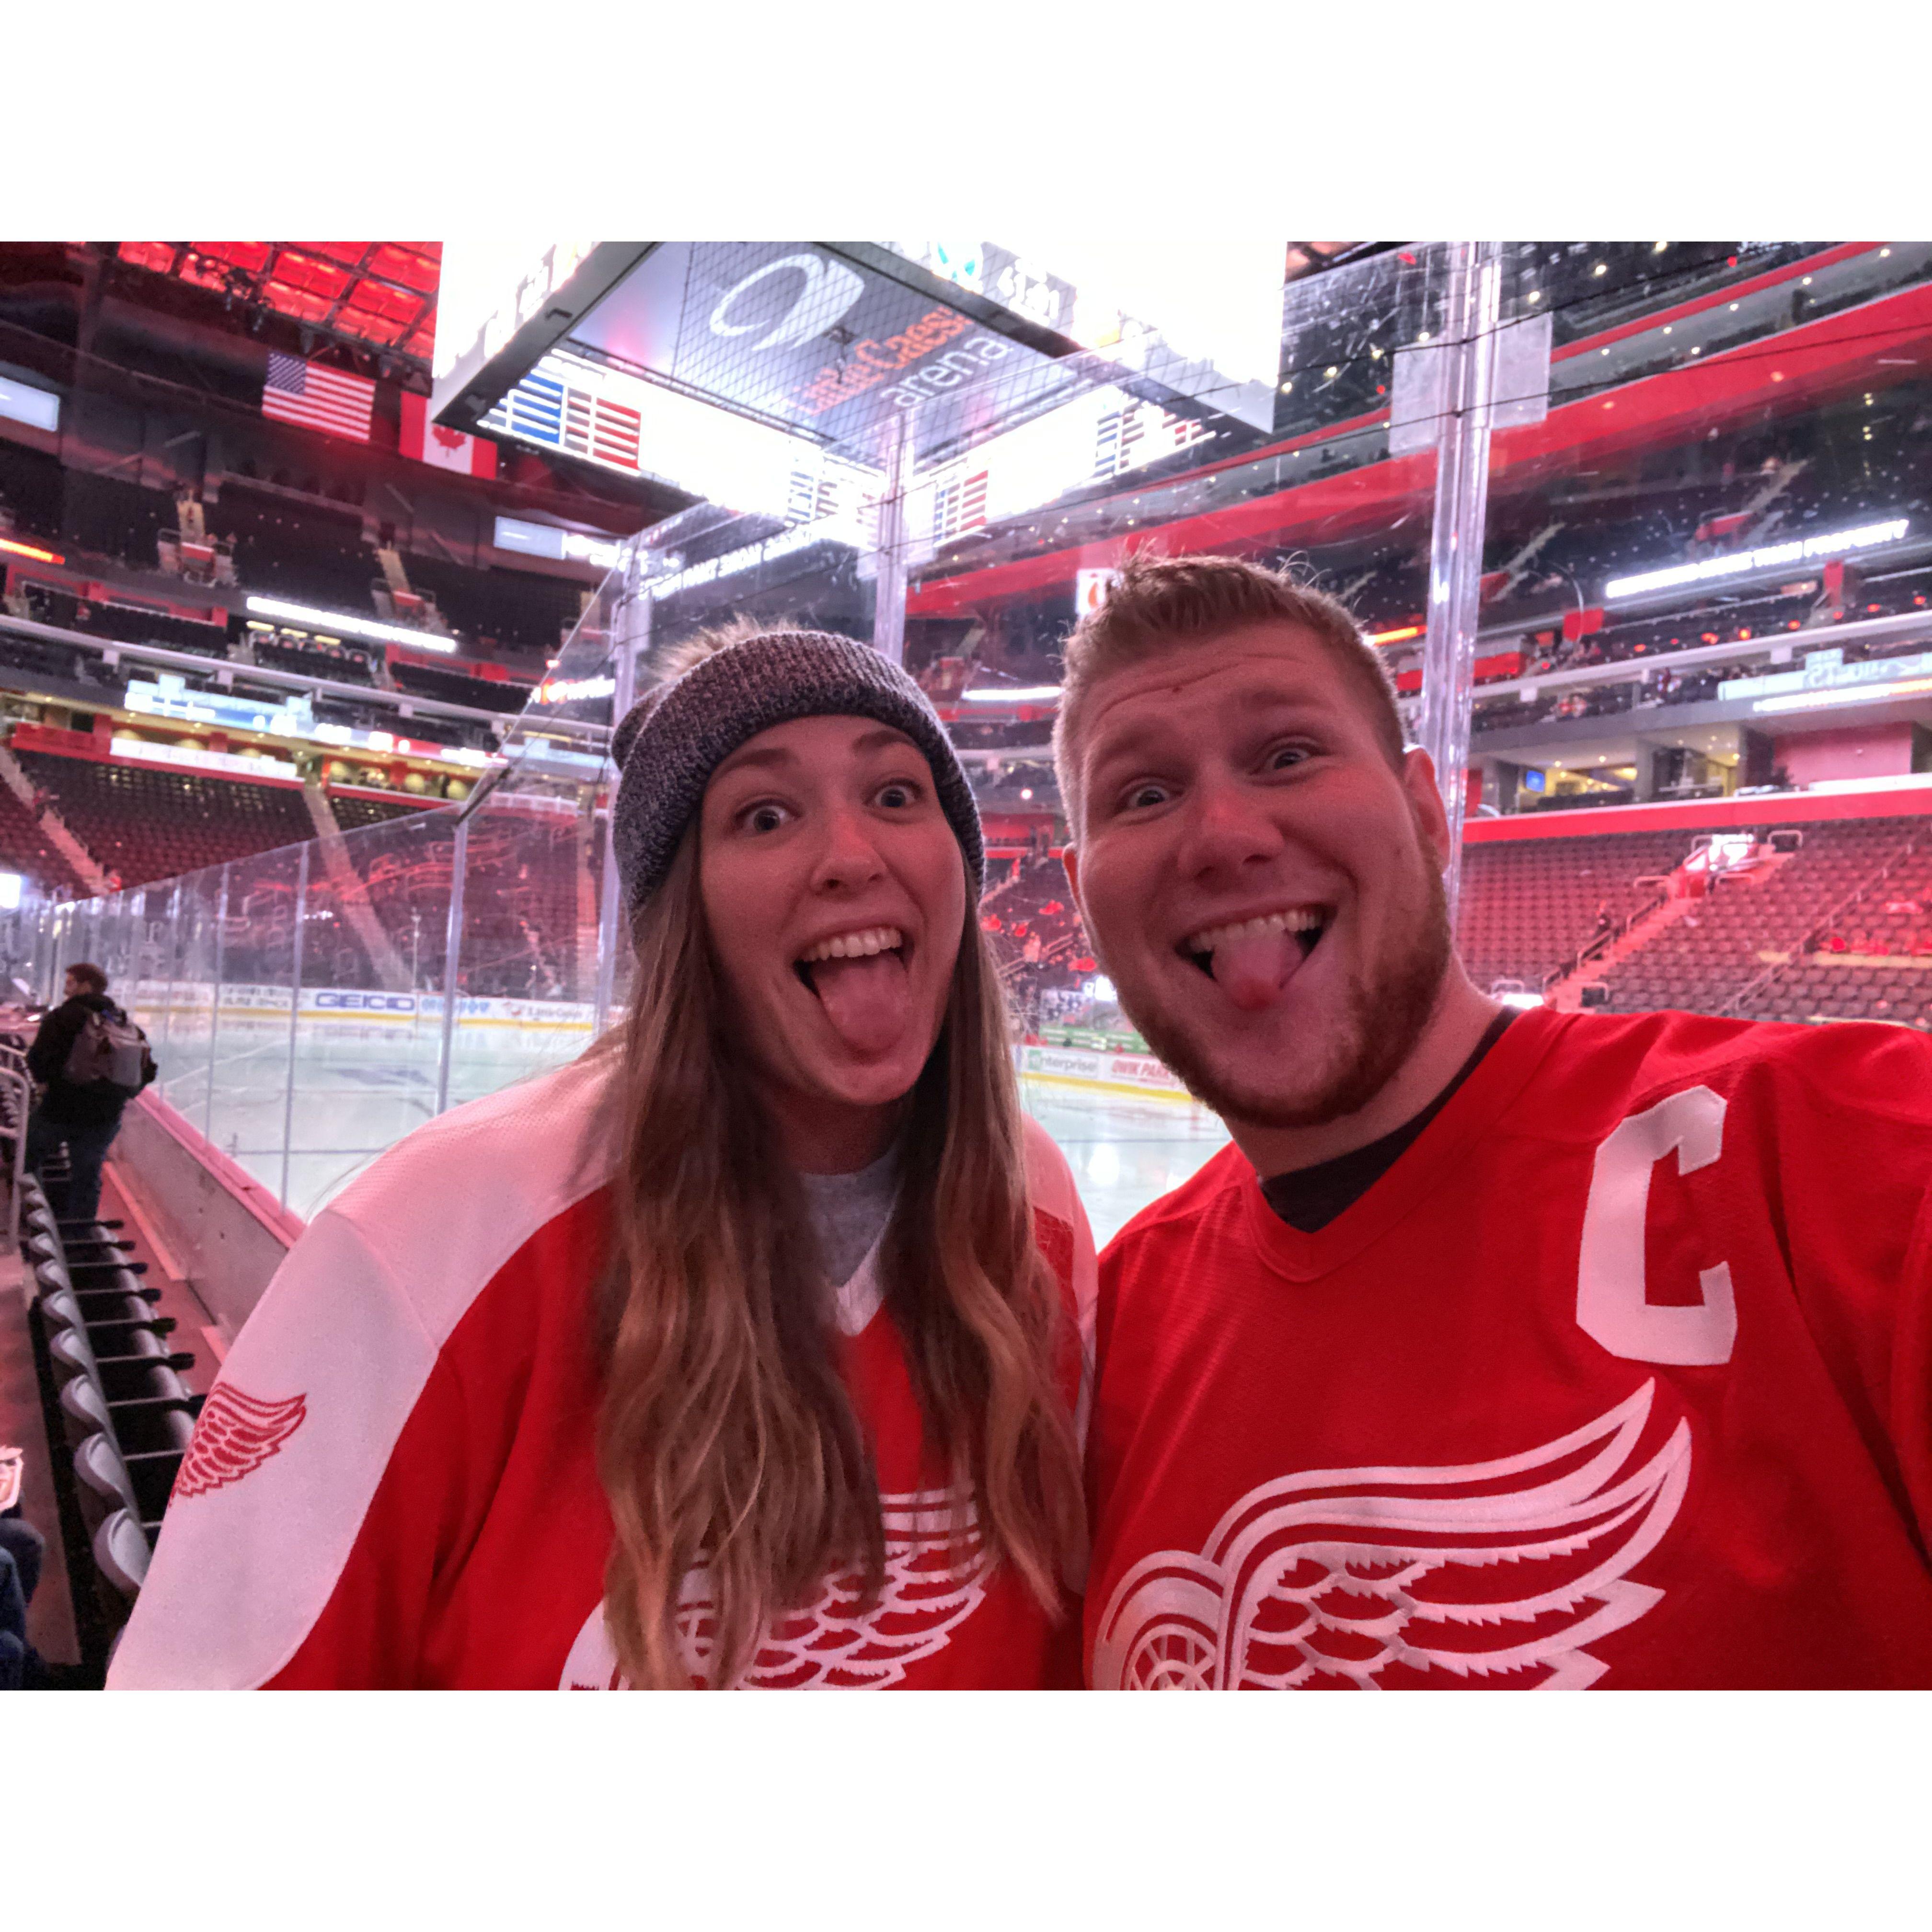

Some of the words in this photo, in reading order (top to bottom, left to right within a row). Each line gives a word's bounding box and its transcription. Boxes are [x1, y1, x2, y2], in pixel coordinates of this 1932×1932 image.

[880, 337, 1013, 407] arena
[315, 992, 414, 1011] GEICO
[1576, 1085, 1738, 1366] C
